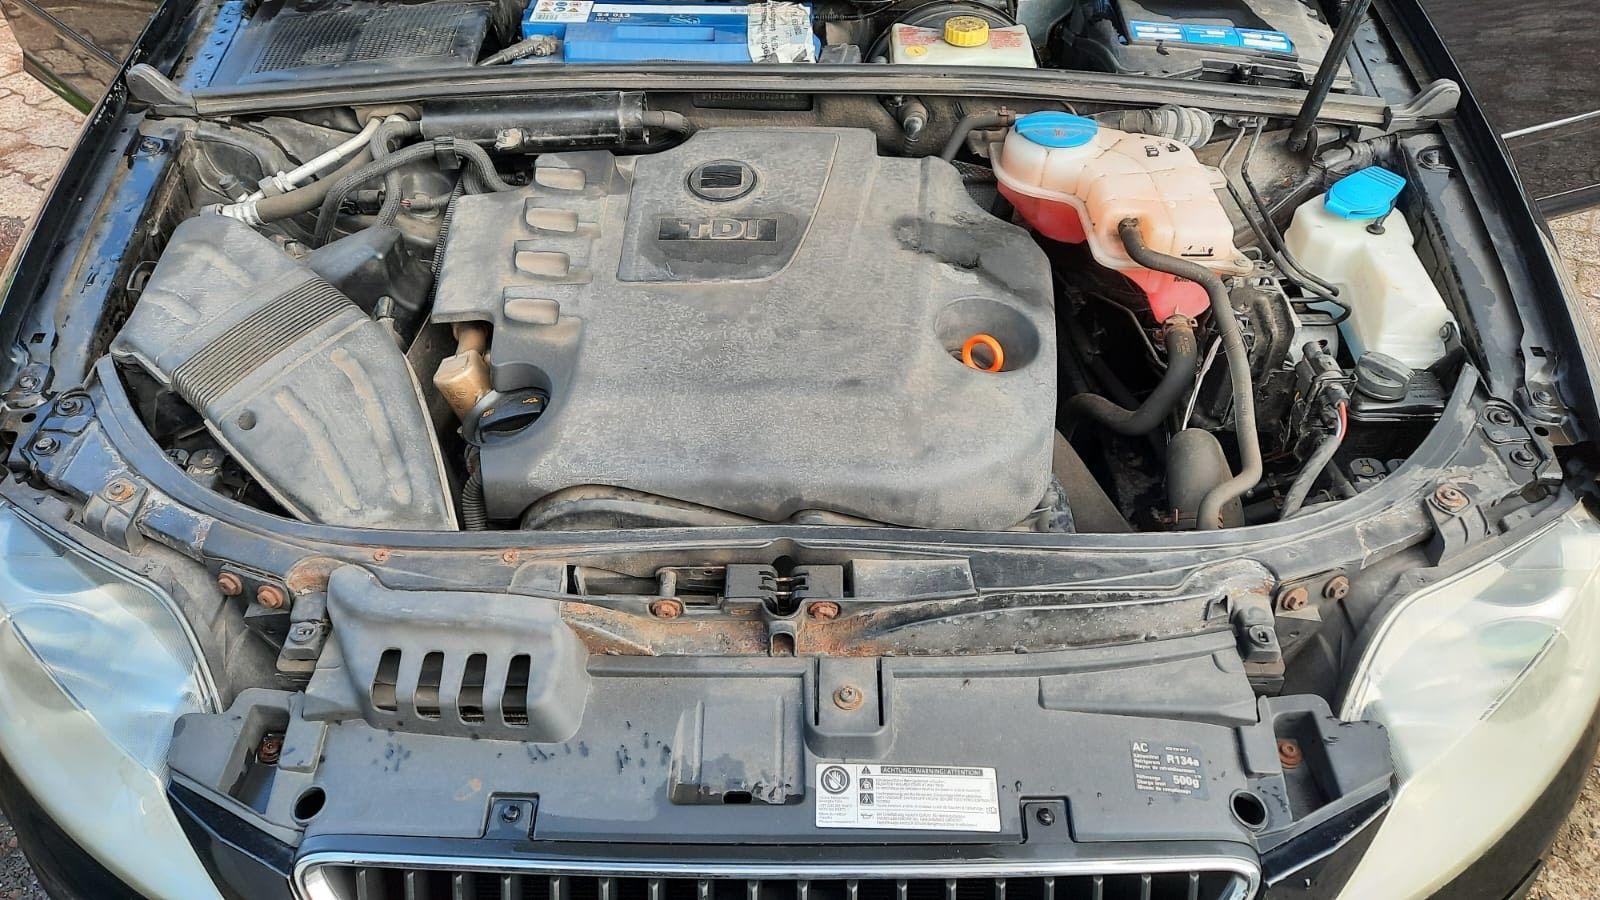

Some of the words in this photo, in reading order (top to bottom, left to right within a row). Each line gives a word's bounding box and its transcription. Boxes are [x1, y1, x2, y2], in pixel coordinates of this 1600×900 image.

[679, 218, 759, 240] TDI
[1132, 742, 1149, 753] AC
[1166, 754, 1200, 767] R134a
[1172, 775, 1200, 789] 500g
